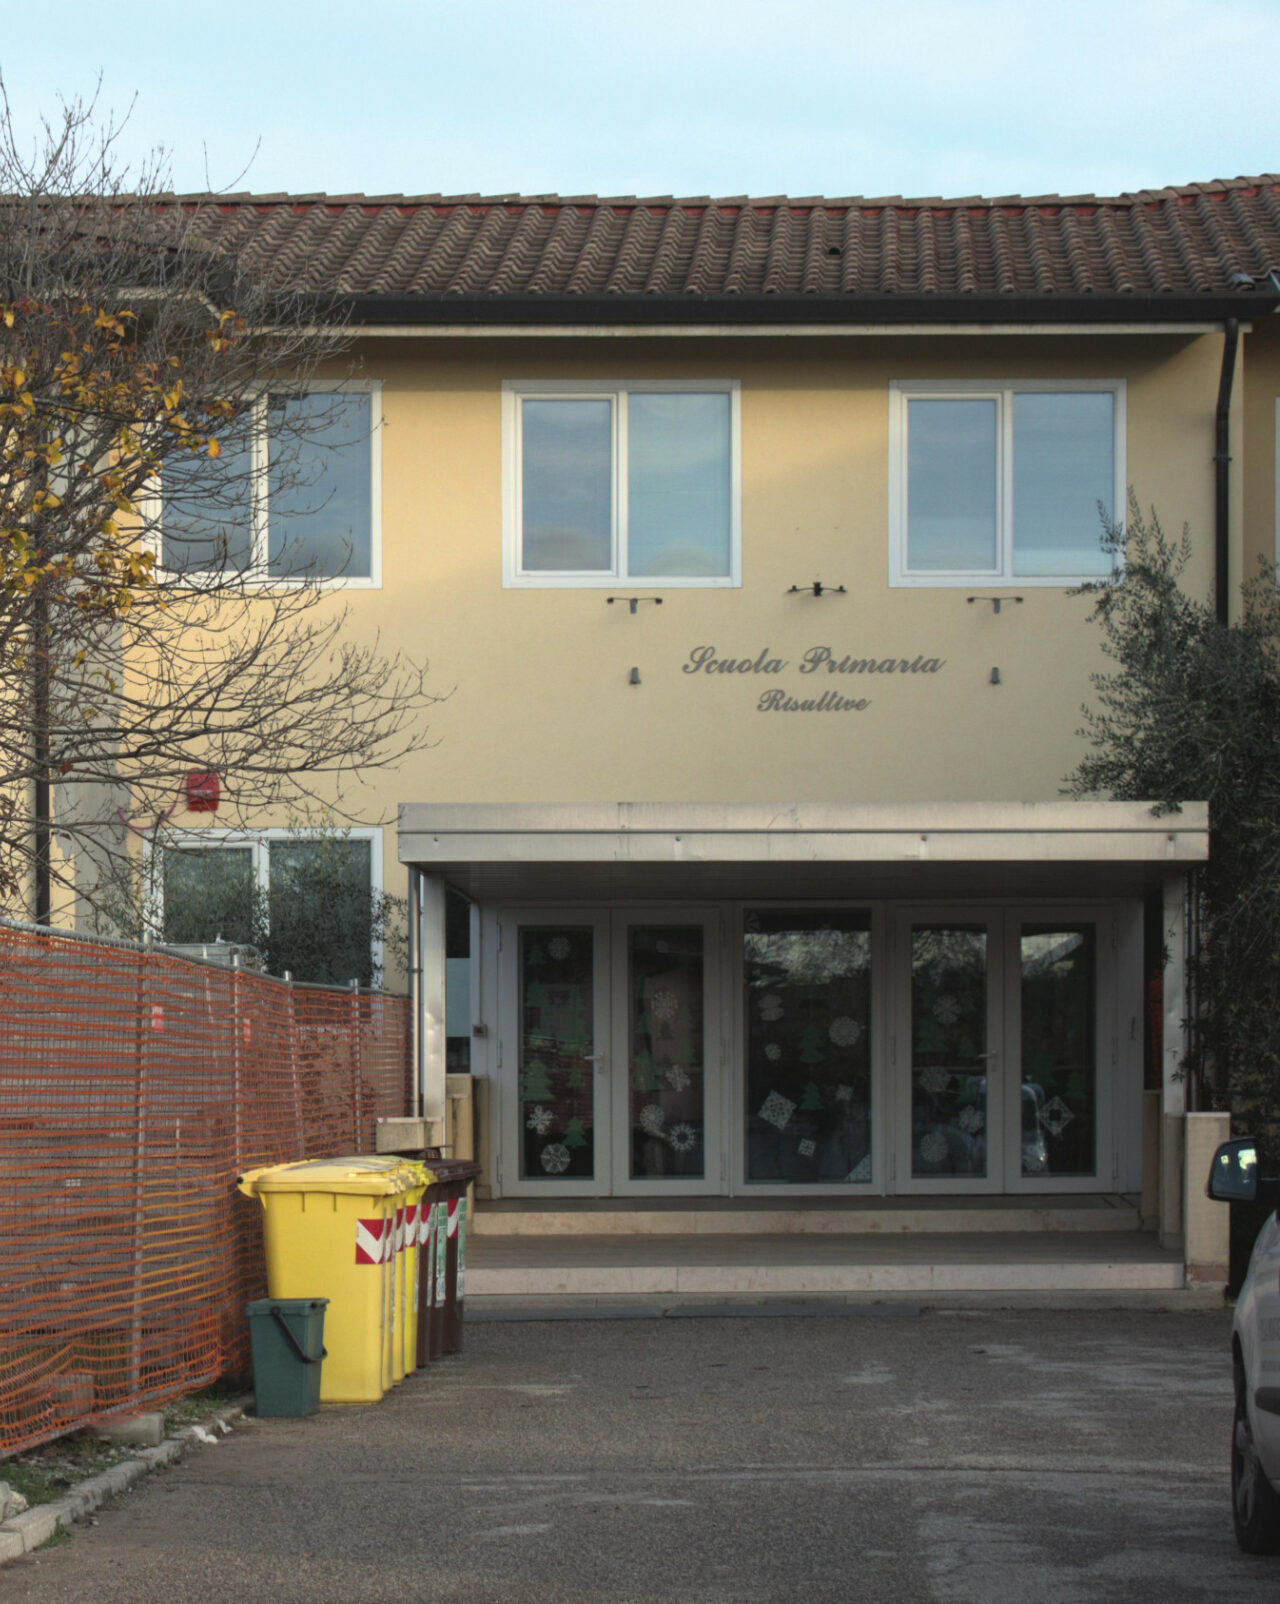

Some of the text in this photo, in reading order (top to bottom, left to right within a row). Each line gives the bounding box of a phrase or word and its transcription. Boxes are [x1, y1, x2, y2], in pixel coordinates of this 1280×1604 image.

[682, 646, 947, 674] Scuola Primaria
[757, 689, 872, 712] Risultive
